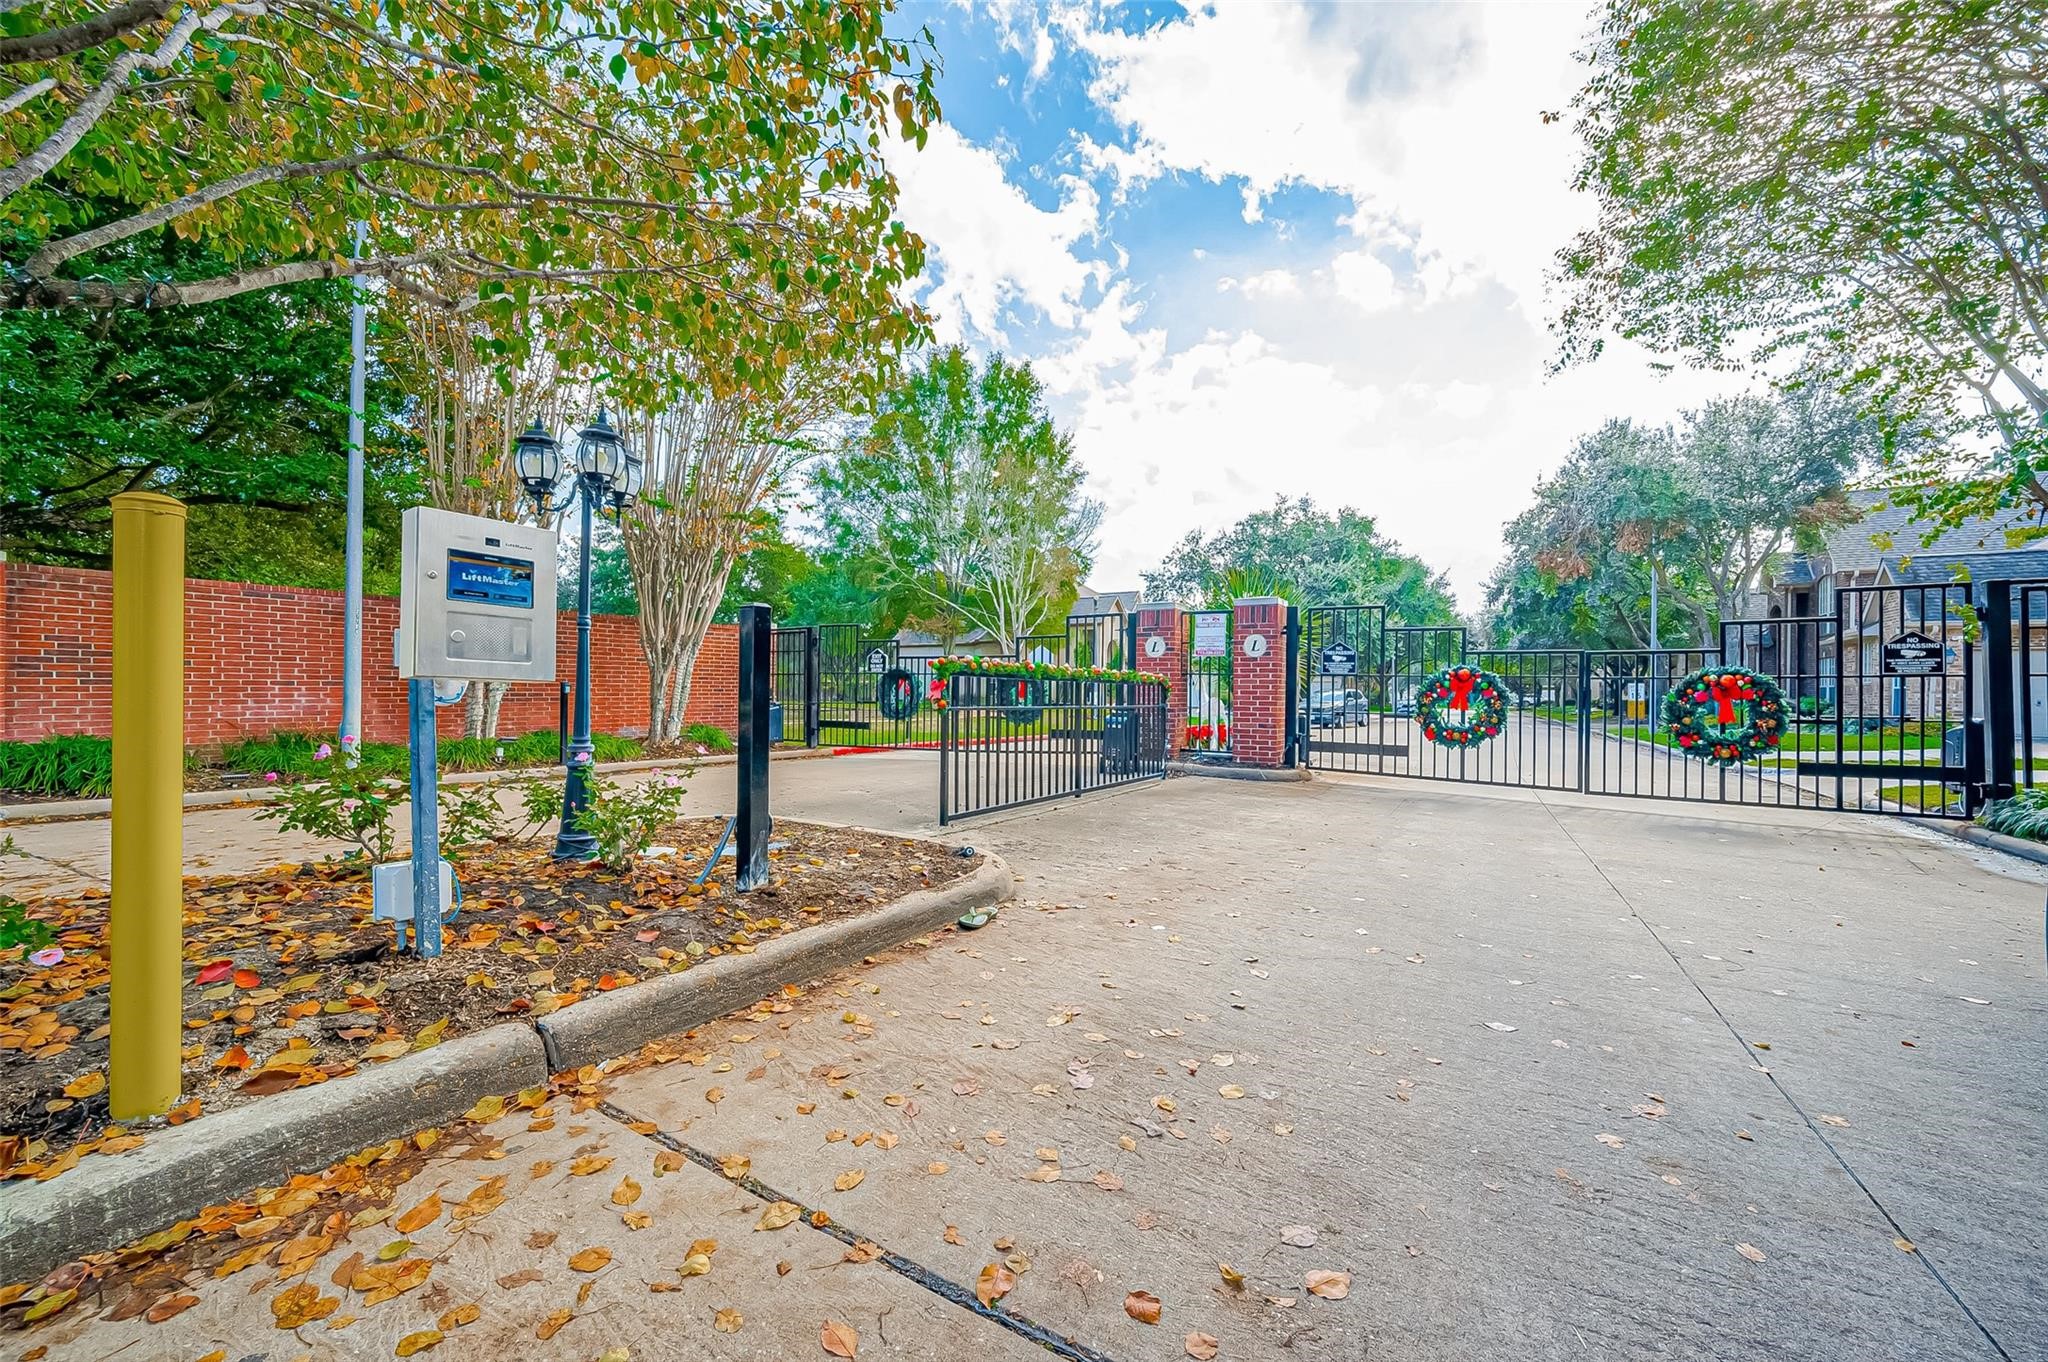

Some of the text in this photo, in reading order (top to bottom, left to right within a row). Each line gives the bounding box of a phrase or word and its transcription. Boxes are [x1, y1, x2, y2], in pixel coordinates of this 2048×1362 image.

[462, 572, 519, 586] LiftMaster
[1151, 641, 1159, 653] L
[1251, 640, 1260, 652] L
